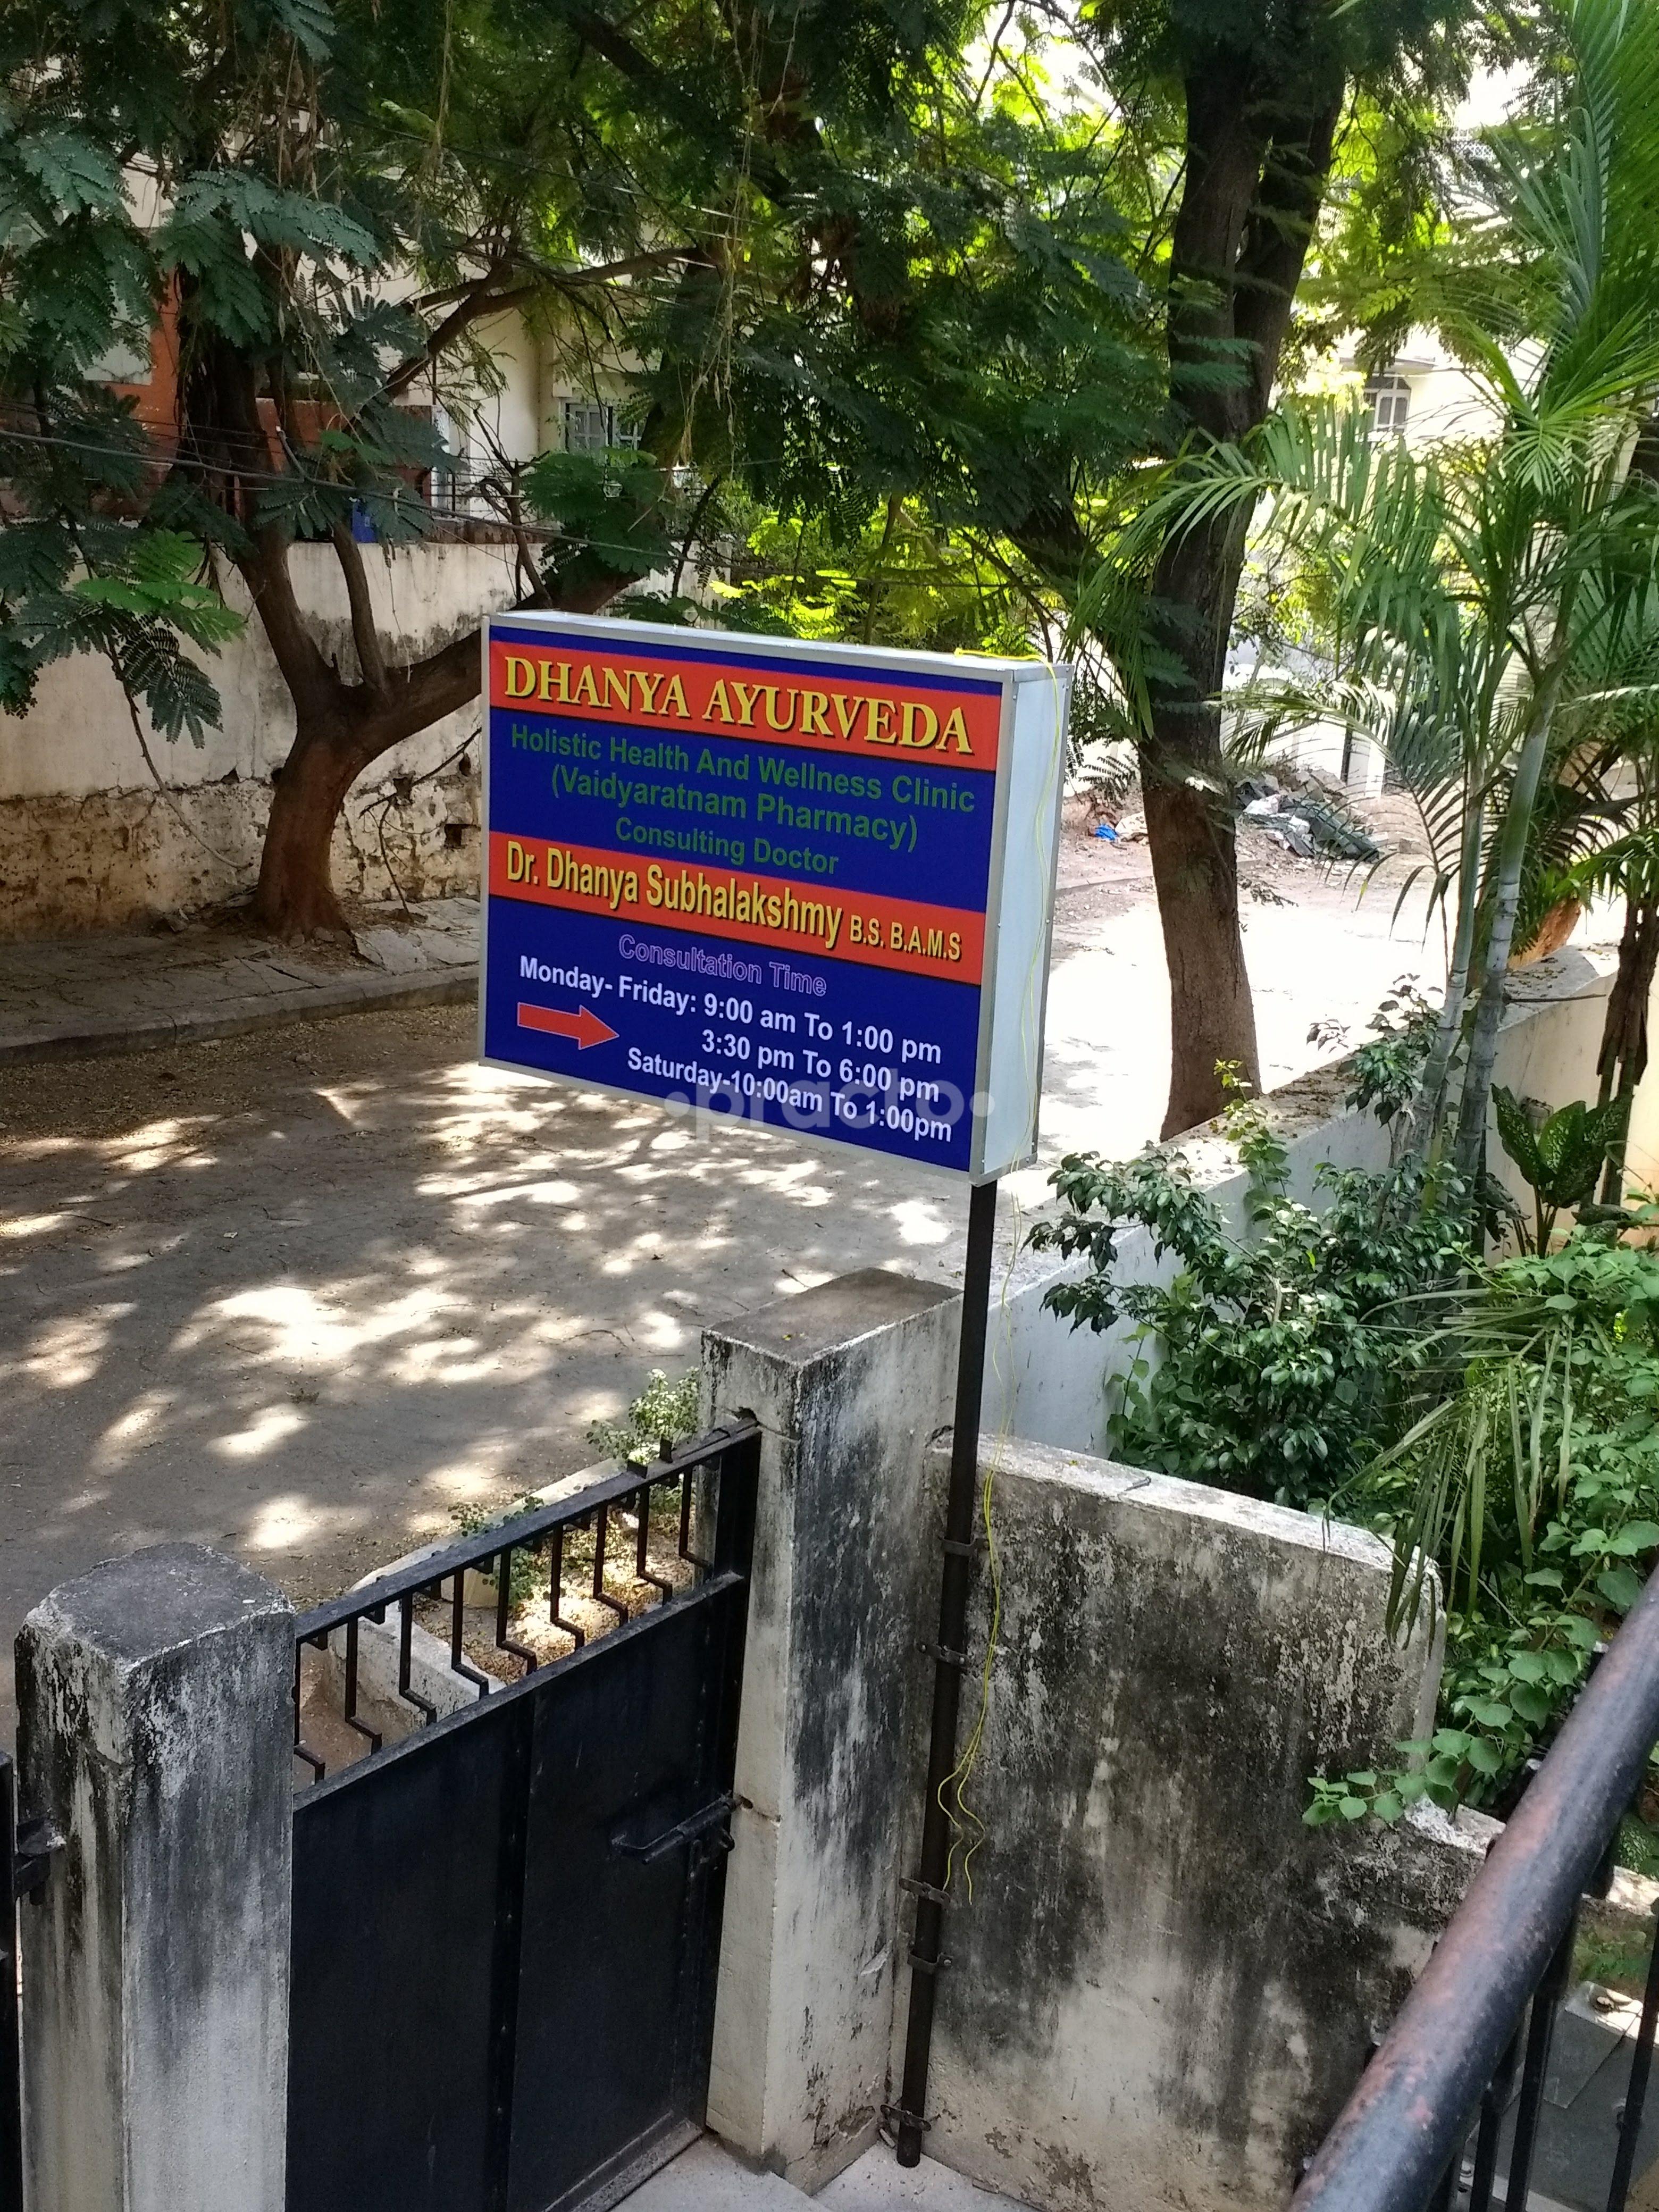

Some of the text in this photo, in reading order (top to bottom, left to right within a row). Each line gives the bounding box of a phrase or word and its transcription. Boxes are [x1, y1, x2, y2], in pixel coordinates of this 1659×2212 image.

[505, 656, 973, 753] DHANYA AYURVEDA
[512, 723, 975, 812] Holistic Health And Wellness Clinic
[551, 764, 917, 853] (Vaidyaratnam Pharmacy)
[616, 817, 839, 874] Consulting Doctor
[507, 841, 539, 884] Dr.
[547, 847, 639, 910] Dhanya
[646, 864, 842, 949] Subhalakshmy
[520, 956, 941, 1063] Monday- Friday: 9:00 am To 1:00 pm
[619, 934, 827, 996] Consultation Time
[702, 1029, 939, 1102] 3:30 pm To 6:00 pm
[831, 1091, 857, 1120] To
[866, 1103, 952, 1143] 1:00pm
